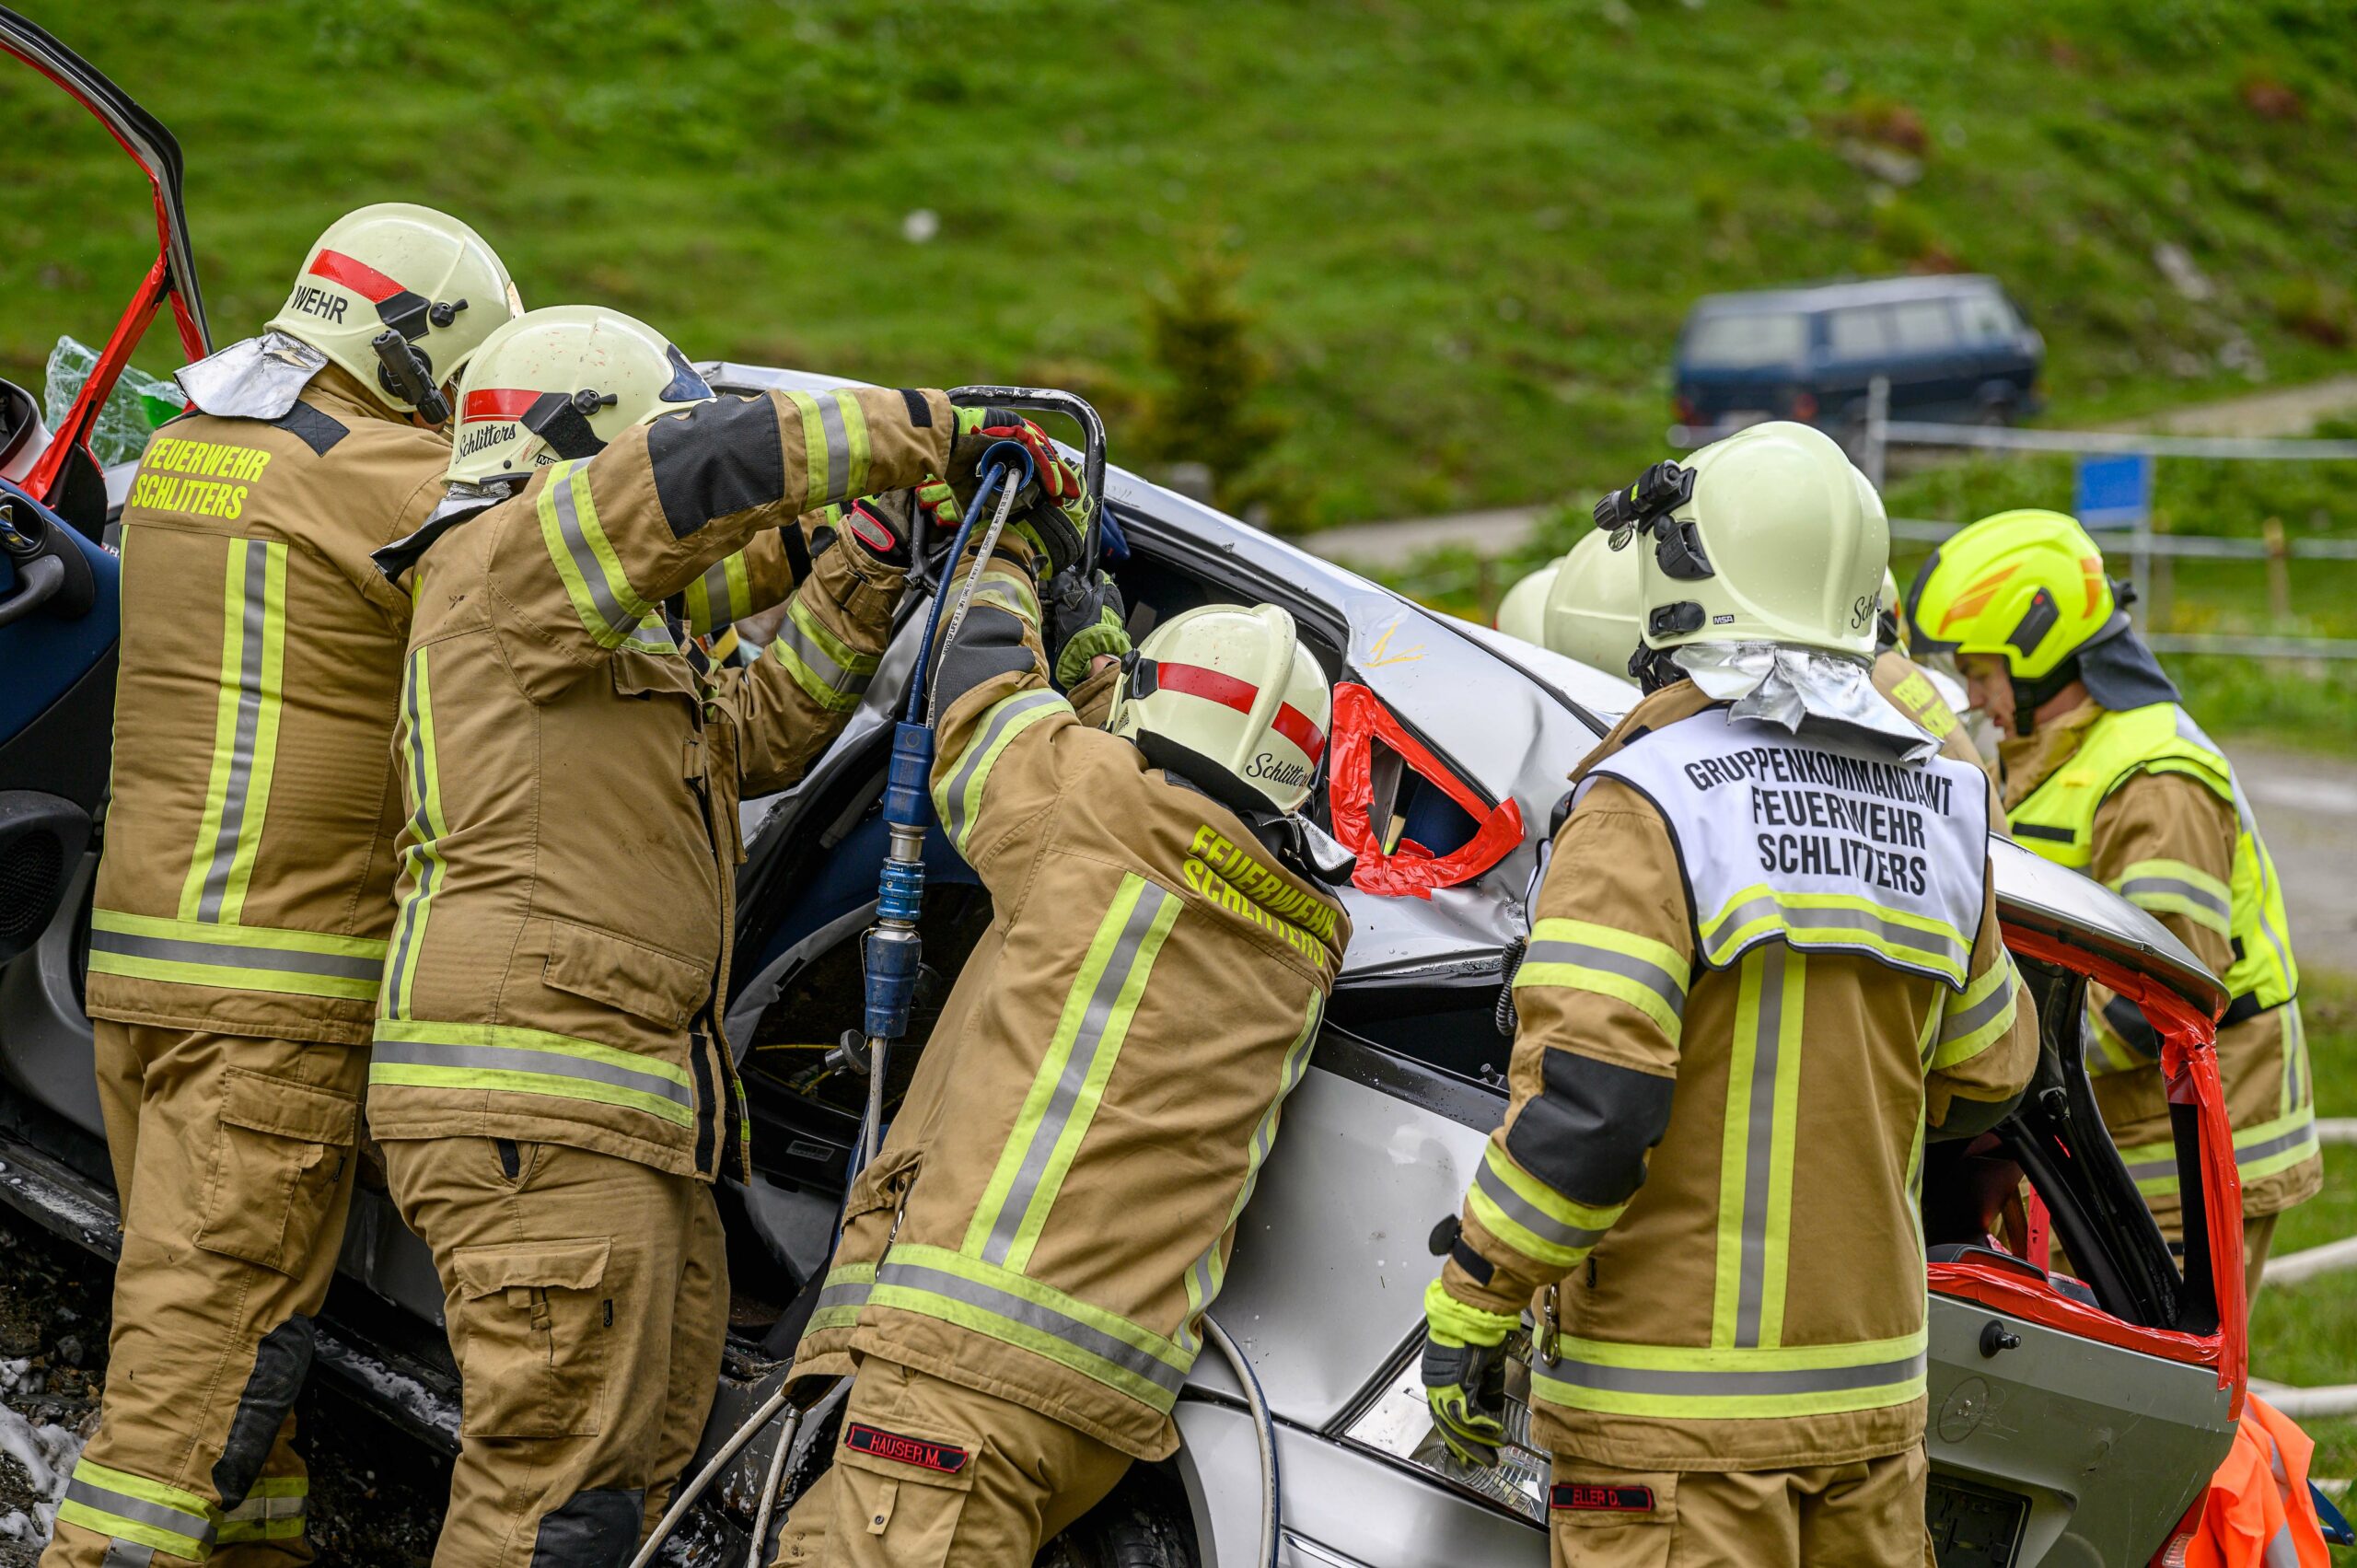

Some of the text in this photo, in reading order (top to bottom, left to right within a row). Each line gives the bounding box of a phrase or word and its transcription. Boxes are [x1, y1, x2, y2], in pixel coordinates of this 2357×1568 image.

[291, 285, 349, 324] WEHR
[143, 437, 272, 483] FEUERWEHR
[455, 424, 517, 465] Schlitters
[132, 473, 249, 520] SCHLITTERS
[1713, 615, 1734, 625] MSA
[1684, 747, 1953, 816] GRUPPENKOMMANDANT
[1751, 785, 1926, 850] FEUERWEHR
[1188, 824, 1338, 942] FEUERWEHR
[1757, 833, 1927, 896] SCHLITTERS
[869, 1434, 941, 1467] HAUSER M.
[1573, 1488, 1606, 1506] ELLER
